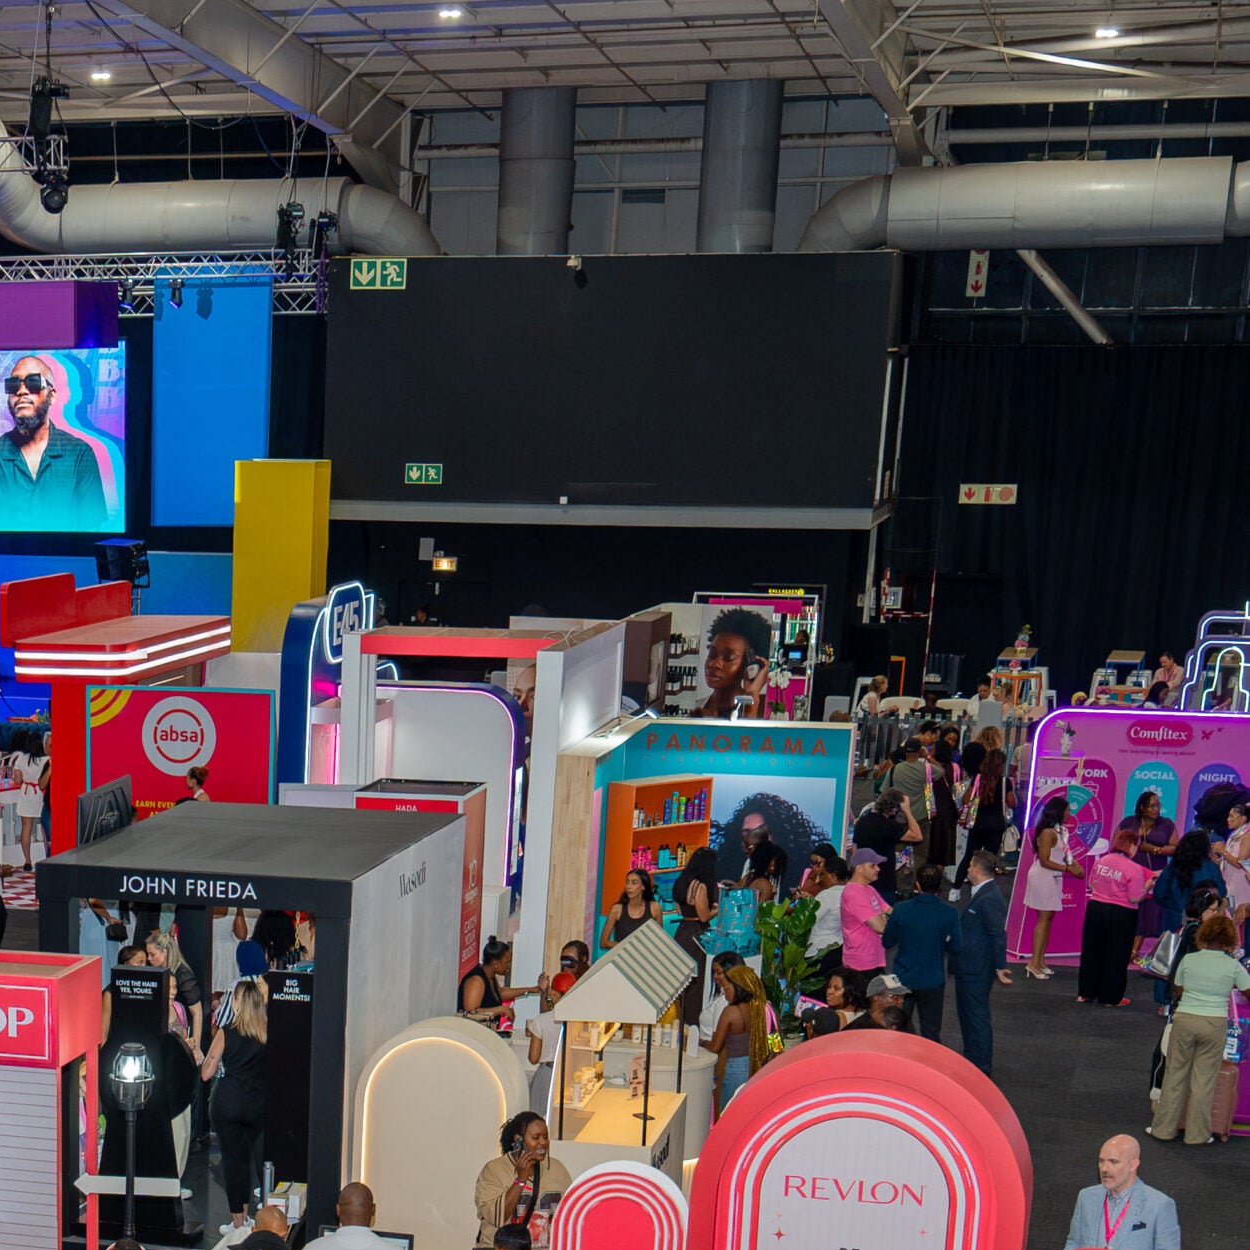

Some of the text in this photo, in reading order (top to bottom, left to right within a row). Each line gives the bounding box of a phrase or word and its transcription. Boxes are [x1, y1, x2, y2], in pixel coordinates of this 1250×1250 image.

[333, 600, 359, 646] E45
[159, 725, 199, 742] absa
[1130, 726, 1188, 742] Comfitex
[646, 733, 827, 756] PANORAMA
[1134, 770, 1175, 780] SOCIAL
[1199, 773, 1236, 782] NIGHT
[135, 800, 155, 809] EARN
[1096, 864, 1123, 882] TEAM
[119, 875, 258, 901] JOHN FRIEDA
[284, 986, 300, 994] HAIR
[285, 979, 298, 987] BIG
[783, 1175, 925, 1207] REVLON
